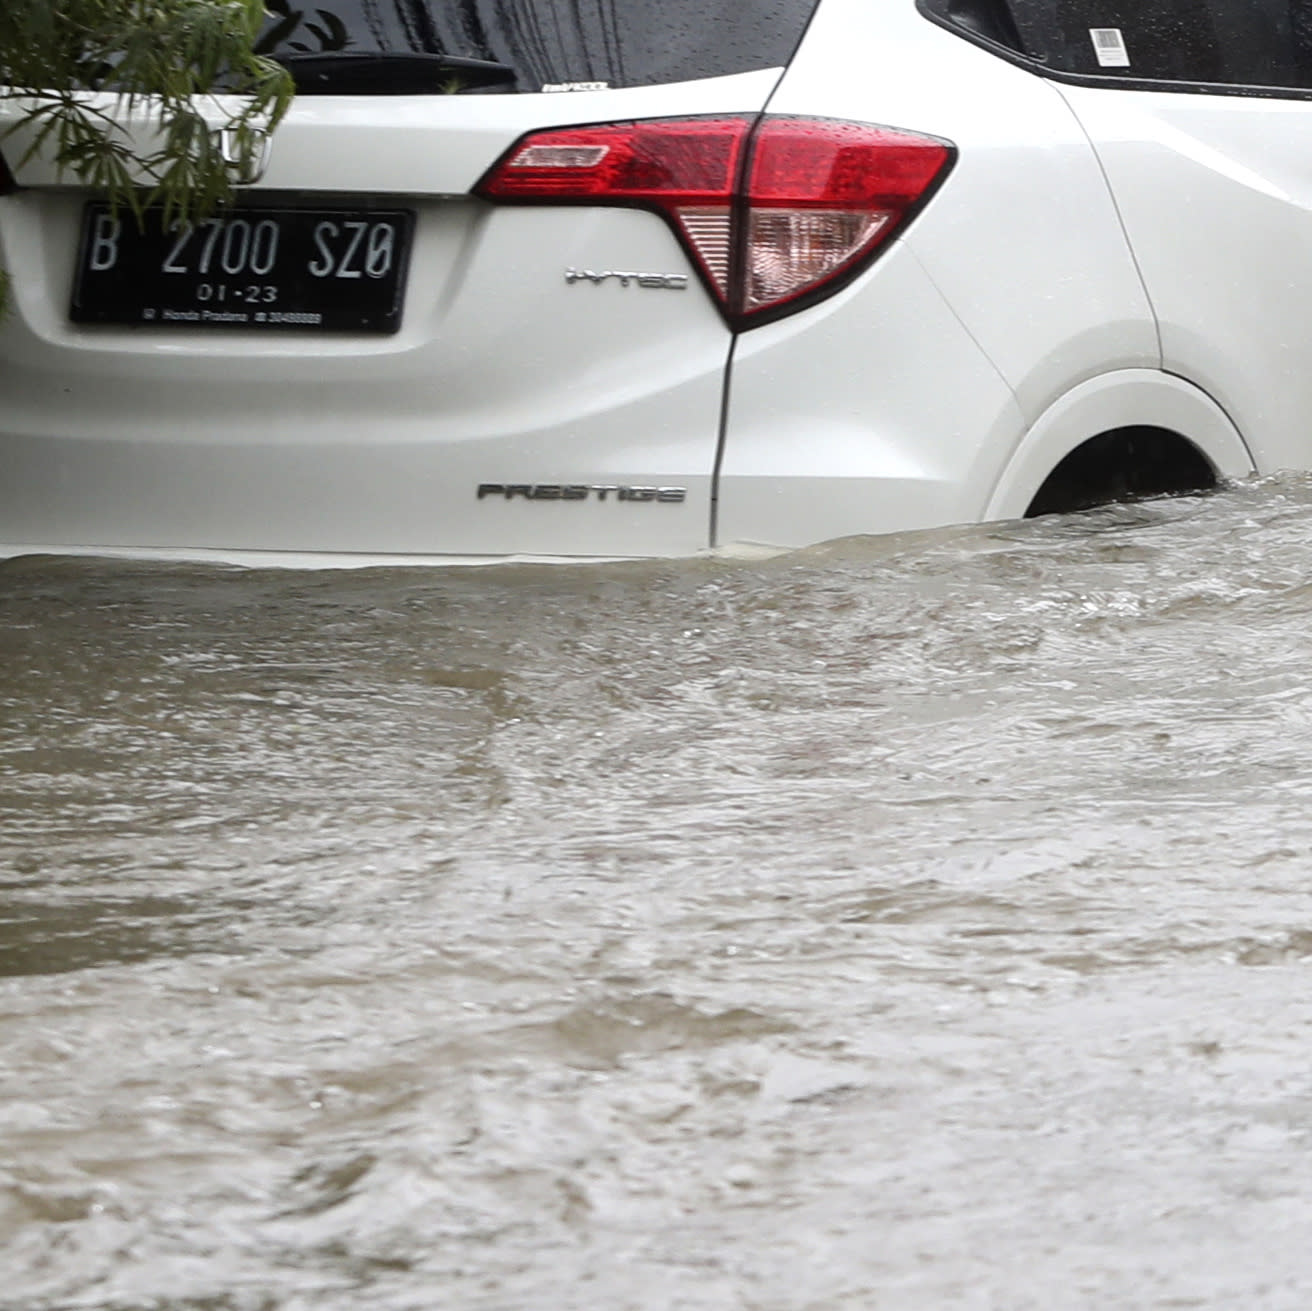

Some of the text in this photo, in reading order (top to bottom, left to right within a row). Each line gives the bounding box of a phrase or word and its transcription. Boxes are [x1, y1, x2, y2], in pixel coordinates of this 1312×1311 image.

[90, 214, 122, 271] B
[162, 218, 280, 276] 2700
[477, 483, 688, 504] PRESTIGE
